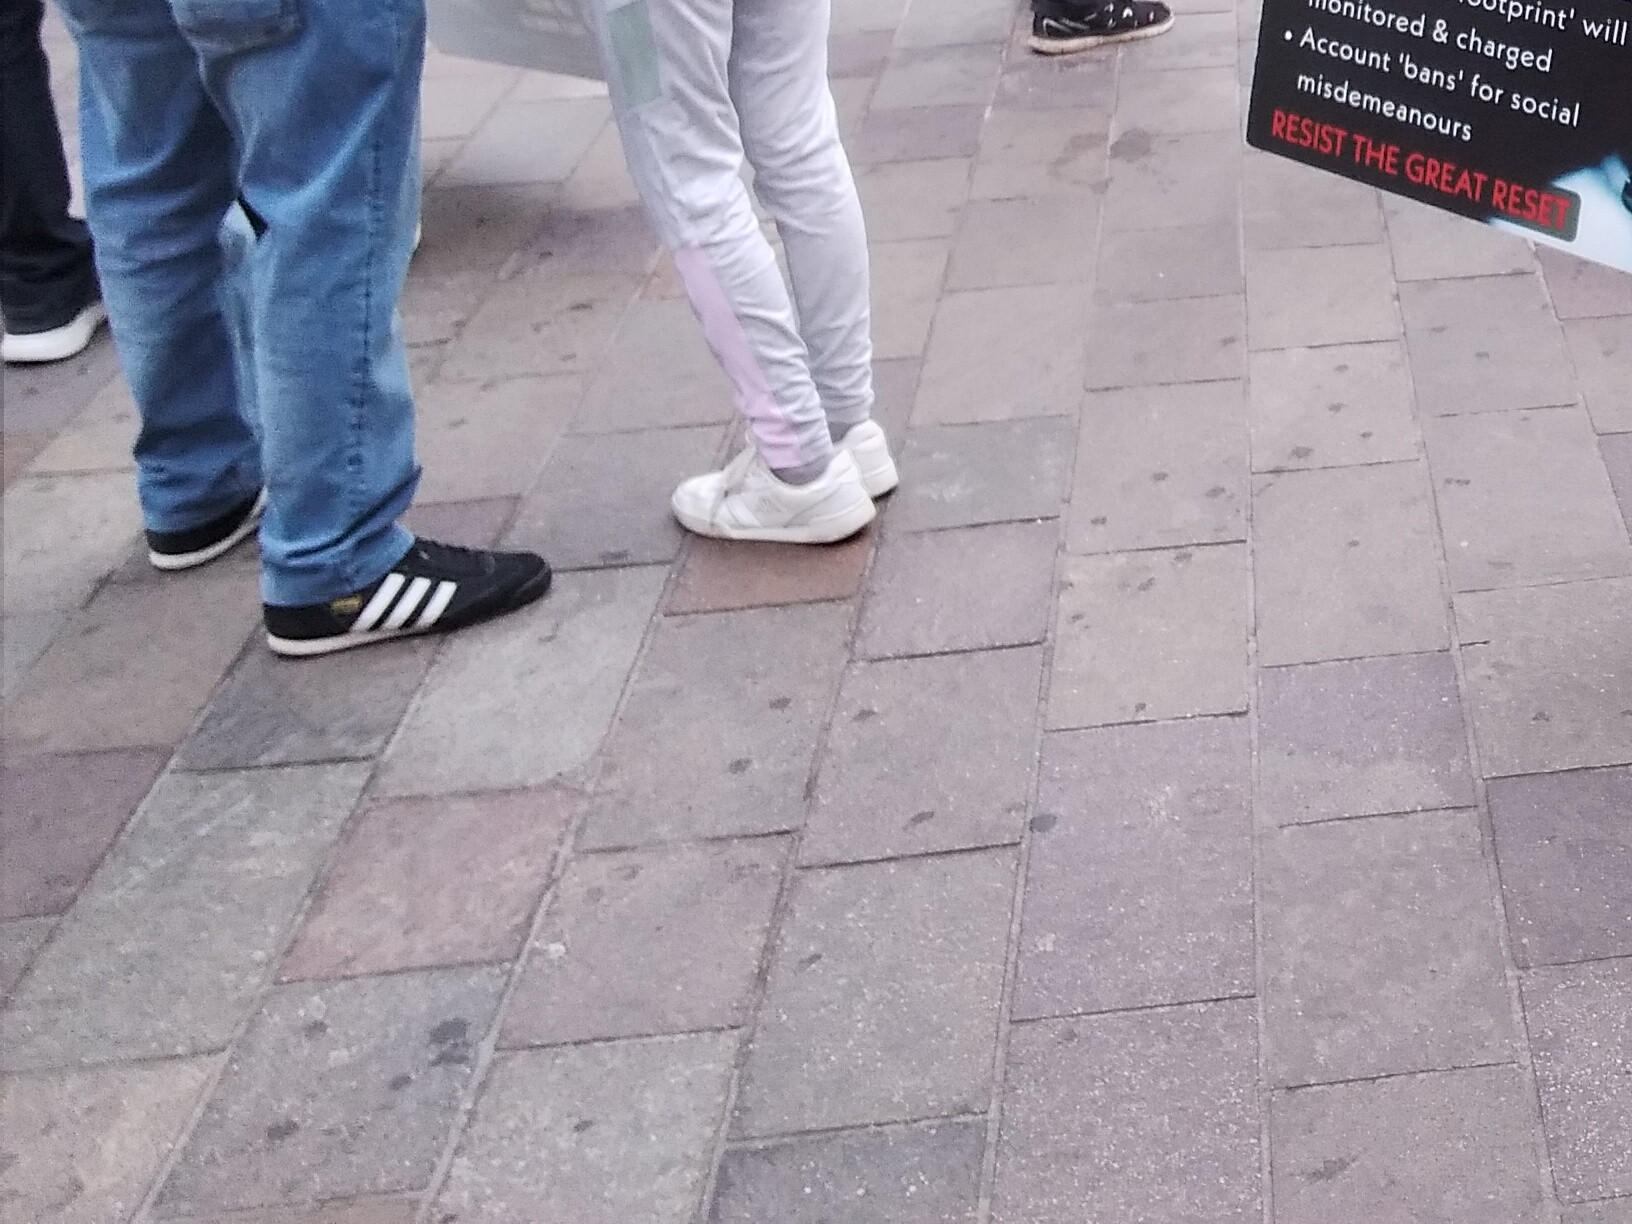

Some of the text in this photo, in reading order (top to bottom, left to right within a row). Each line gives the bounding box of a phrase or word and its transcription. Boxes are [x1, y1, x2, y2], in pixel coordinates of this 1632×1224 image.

[1432, 20, 1449, 43] &
[1456, 27, 1553, 74] charged
[1582, 19, 1628, 47] will
[1296, 73, 1473, 142] misdemeanours
[1300, 26, 1581, 128] Account 'bans' for social
[1271, 109, 1573, 231] RESIST THE GREAT RESET
